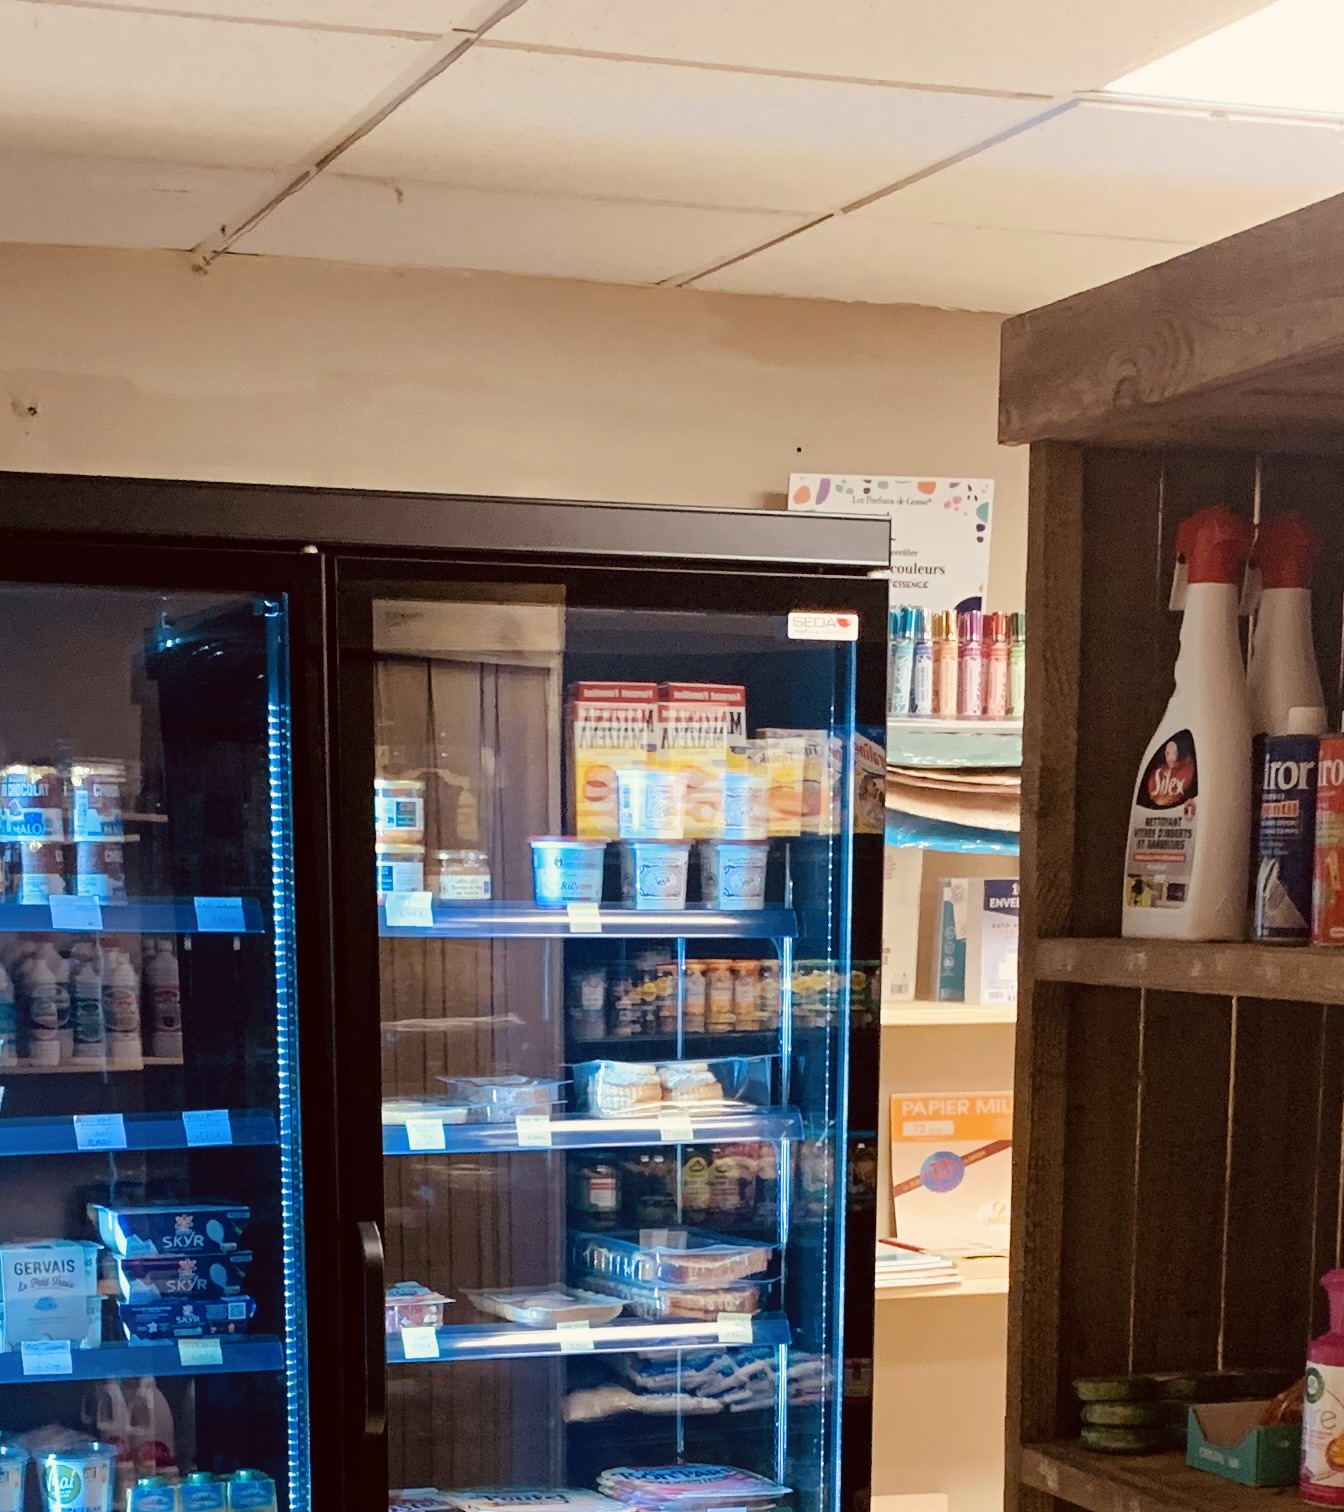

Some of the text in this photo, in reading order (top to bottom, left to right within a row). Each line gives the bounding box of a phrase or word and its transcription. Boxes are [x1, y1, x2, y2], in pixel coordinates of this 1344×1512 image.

[890, 562, 945, 576] couleurs
[792, 616, 837, 629] SEDA
[1263, 753, 1315, 790] iror
[902, 1099, 971, 1116] PAPIER
[162, 1231, 205, 1249] SKYR
[13, 1258, 76, 1277] GERVAIS
[166, 1275, 208, 1293] SKYR
[175, 1314, 201, 1325] SKYR
